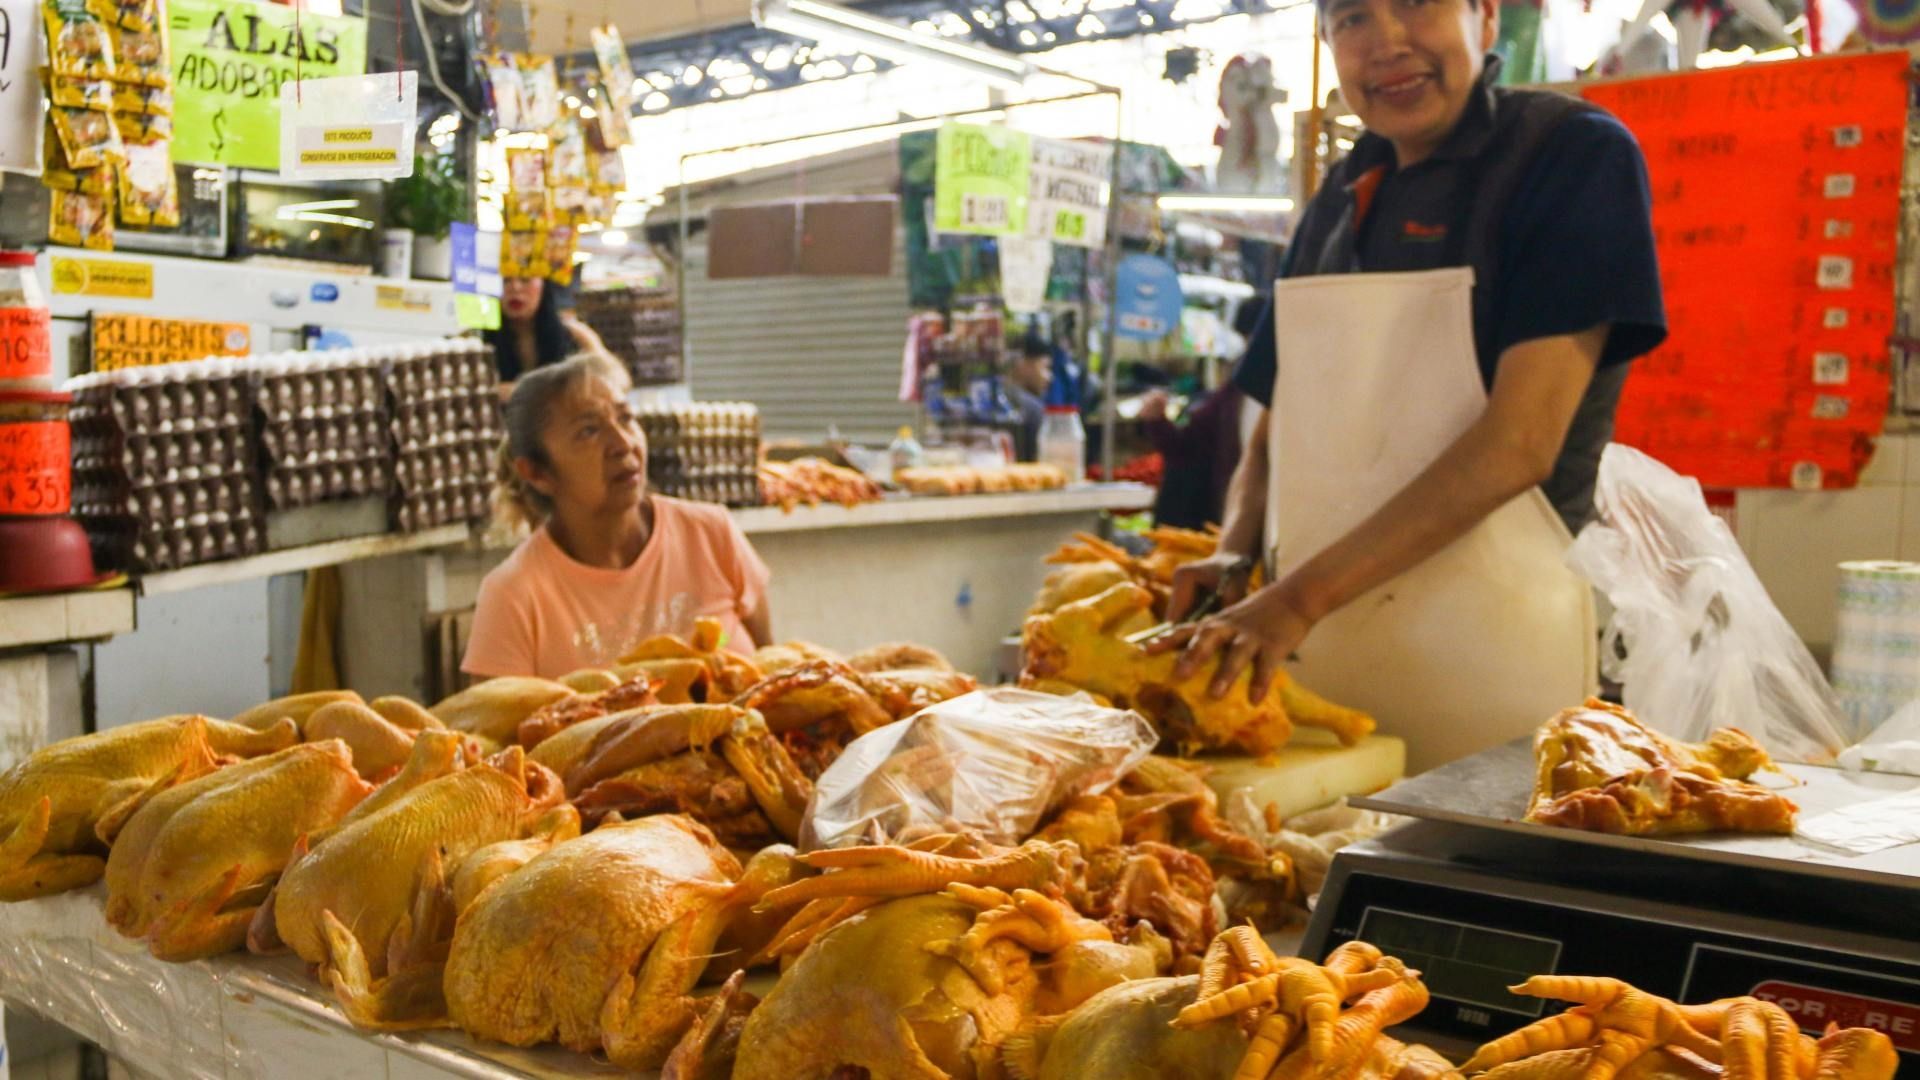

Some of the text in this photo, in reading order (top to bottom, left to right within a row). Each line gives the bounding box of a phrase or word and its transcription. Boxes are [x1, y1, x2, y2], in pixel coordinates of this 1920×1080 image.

[203, 10, 339, 65] ALAS
[178, 54, 330, 98] ADOBA
[324, 130, 373, 142] ESTE PRODUCTO
[338, 152, 347, 161] EN
[1456, 1006, 1491, 1027] TOTAL
